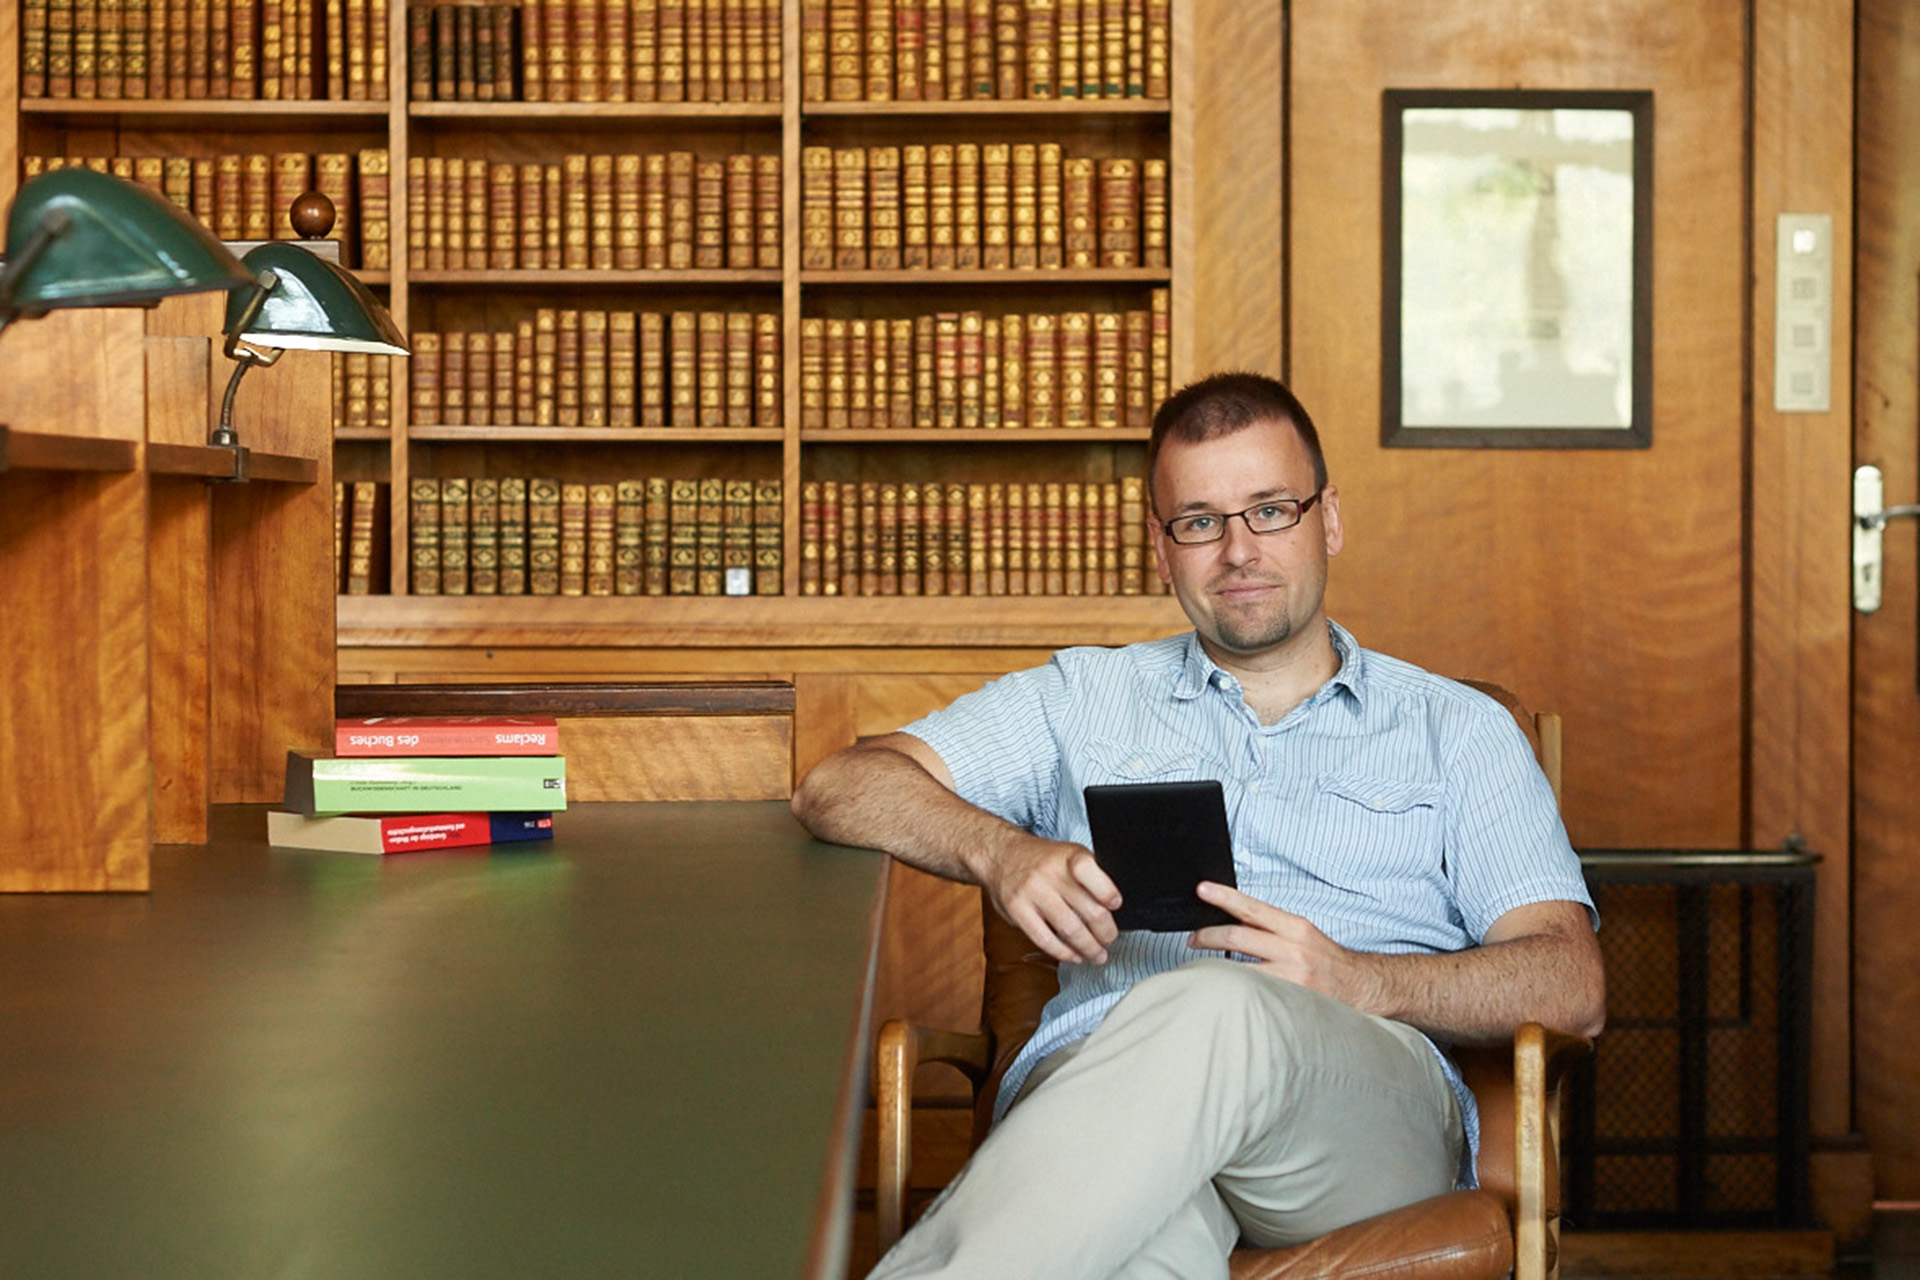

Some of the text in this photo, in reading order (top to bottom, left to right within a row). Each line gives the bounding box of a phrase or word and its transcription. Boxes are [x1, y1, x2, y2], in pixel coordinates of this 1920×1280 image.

[349, 735, 394, 746] Buches
[397, 735, 419, 746] des
[495, 733, 546, 745] Reclams
[455, 823, 466, 831] und
